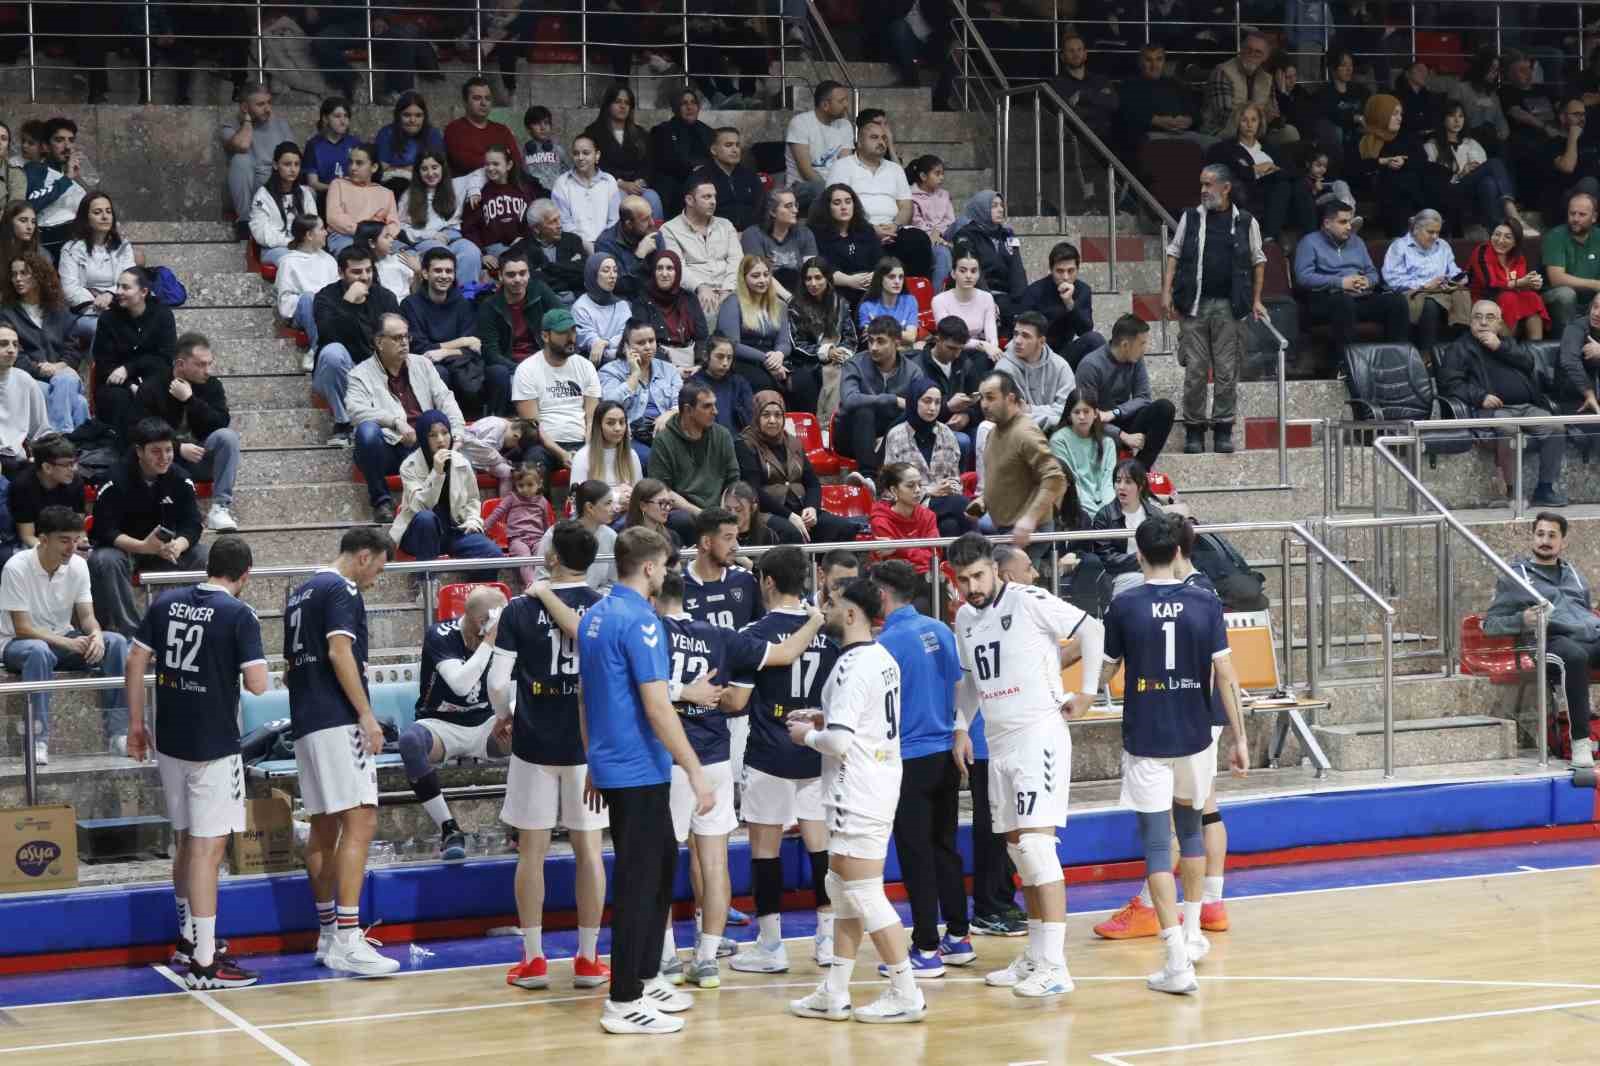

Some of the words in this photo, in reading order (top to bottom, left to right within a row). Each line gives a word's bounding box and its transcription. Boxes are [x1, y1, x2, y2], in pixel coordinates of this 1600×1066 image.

[525, 151, 560, 165] MARVEL
[168, 602, 214, 622] SENCER
[290, 607, 304, 653] 2
[1151, 602, 1184, 618] KAP
[165, 619, 204, 673] 52
[547, 628, 580, 676] 19
[671, 632, 711, 654] YENAL
[974, 640, 1000, 681] 67
[1161, 621, 1176, 670] 1
[791, 651, 821, 698] 17
[884, 687, 899, 740] 9
[1017, 791, 1037, 816] 67
[19, 848, 54, 865] asya
